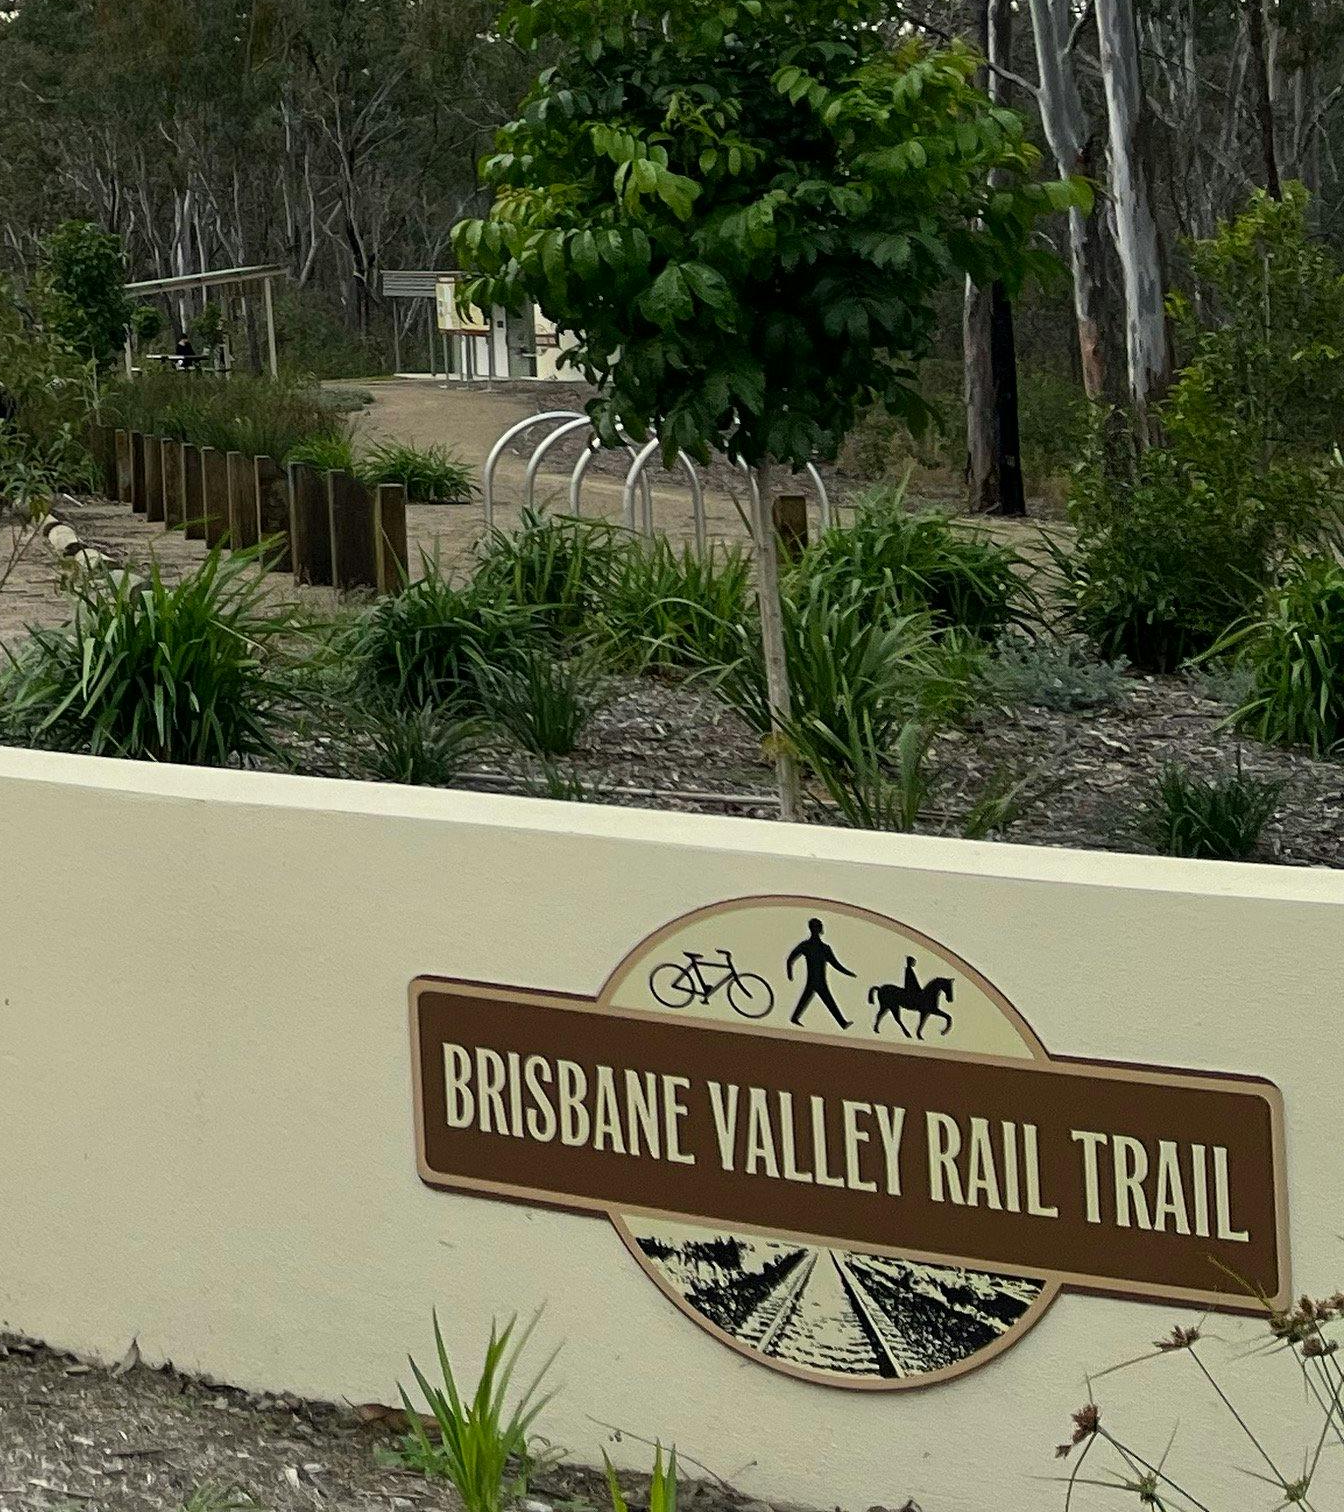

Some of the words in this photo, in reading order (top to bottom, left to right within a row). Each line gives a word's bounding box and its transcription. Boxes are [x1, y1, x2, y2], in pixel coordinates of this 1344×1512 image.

[442, 1042, 696, 1165] BRISBANE
[707, 1080, 906, 1196] VALLEY
[925, 1111, 1059, 1218] RAIL
[1071, 1129, 1250, 1243] TRAIL
